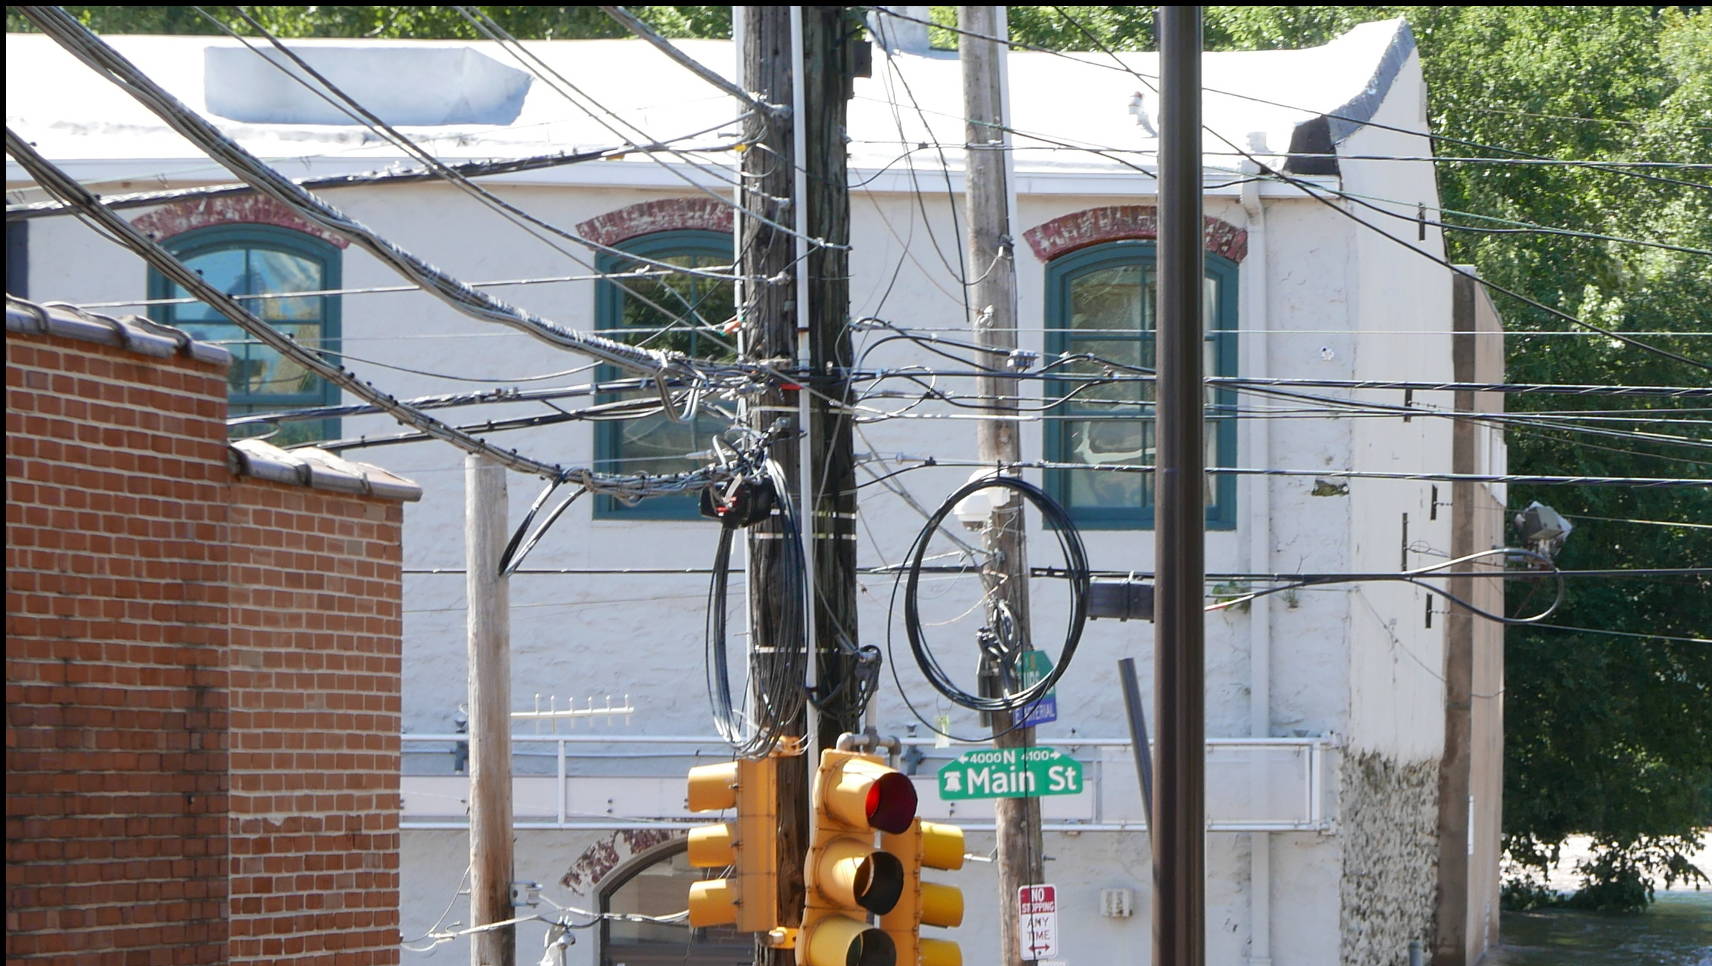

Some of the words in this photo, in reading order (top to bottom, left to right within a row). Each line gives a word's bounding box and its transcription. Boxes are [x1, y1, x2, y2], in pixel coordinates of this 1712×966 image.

[970, 752, 1002, 764] 4000
[1003, 750, 1016, 764] N
[966, 765, 1036, 795] Main
[1048, 765, 1077, 791] St
[1032, 887, 1045, 903] NO
[1027, 930, 1051, 941] TME
